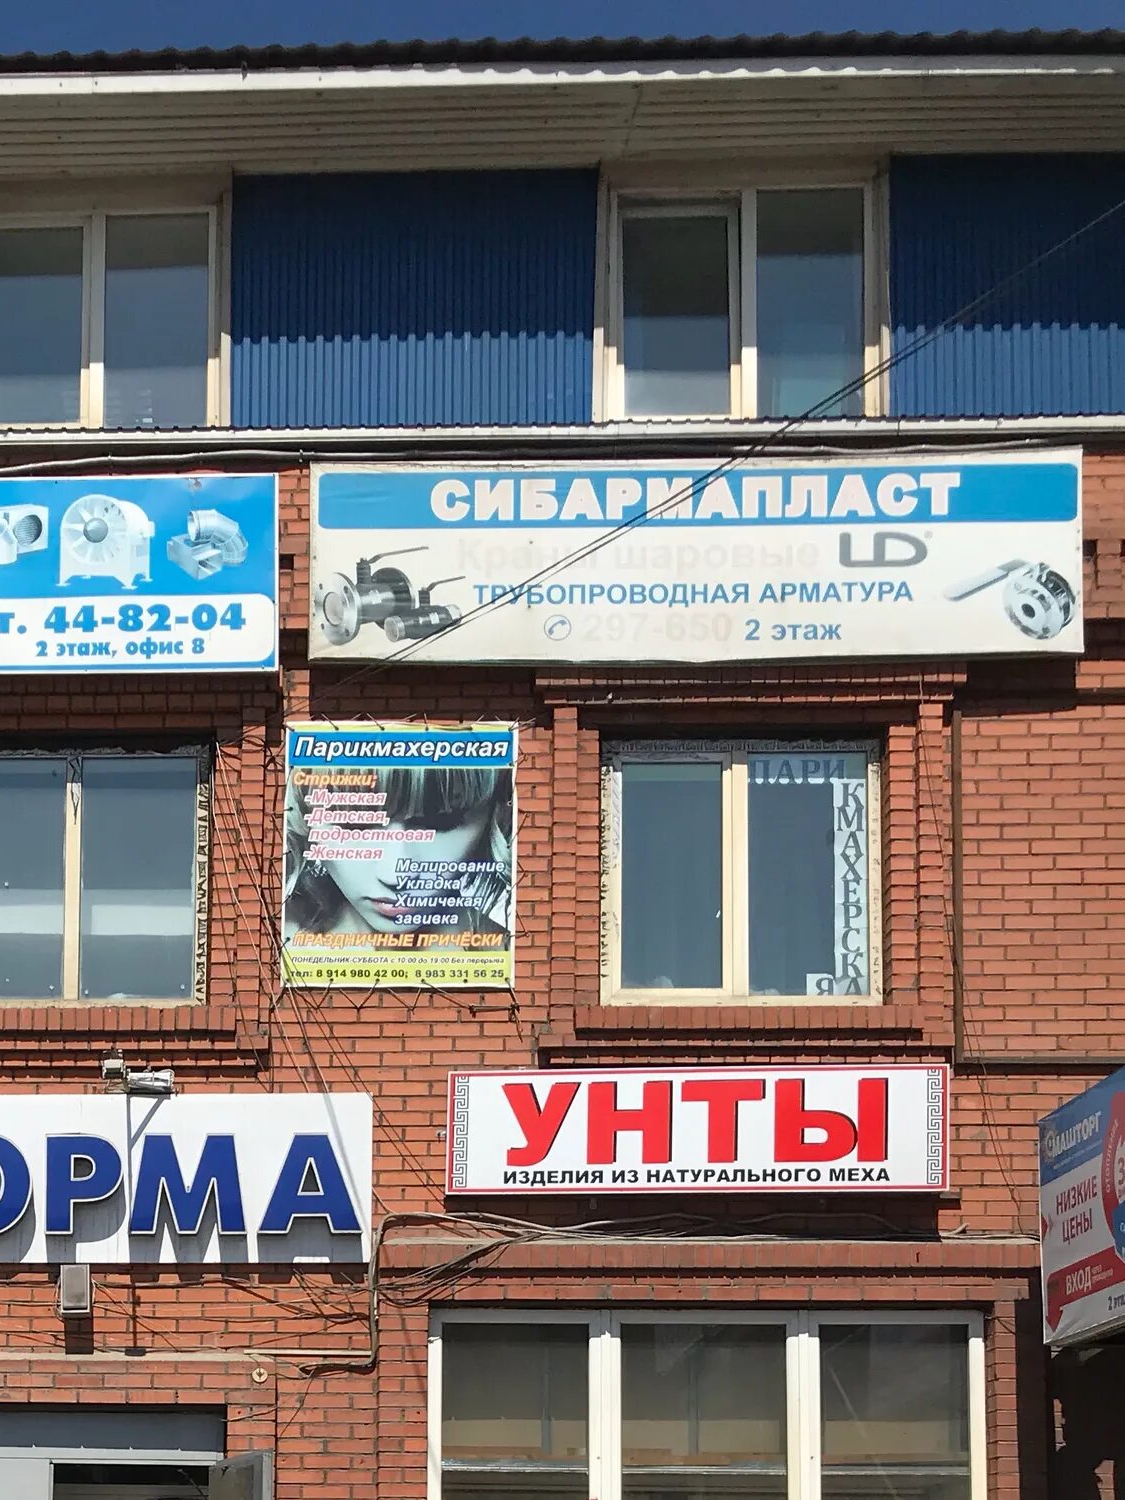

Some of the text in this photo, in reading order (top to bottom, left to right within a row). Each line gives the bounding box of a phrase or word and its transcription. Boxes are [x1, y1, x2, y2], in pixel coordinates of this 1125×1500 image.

[429, 471, 961, 522] СИБАРМАПЛАСТ
[473, 580, 913, 608] ТРУБОПРОВОДНАЯ АРМАТУРА
[44, 603, 246, 633] 44-82-04
[744, 620, 763, 641] 2
[771, 620, 842, 642] этаж
[35, 637, 205, 659] 2 этаж, офис 8
[294, 736, 508, 760] Парикмахерская
[305, 790, 386, 807] -Мужская
[308, 829, 435, 843] подростковая
[303, 846, 382, 860] -Женская
[395, 859, 505, 874] Мелирование
[395, 877, 461, 891] Укладка
[395, 912, 458, 926] завивка
[292, 933, 414, 949] ПРАЗДНИЧНЫЕ
[316, 969, 323, 978] 8
[325, 969, 346, 978] 914
[350, 969, 370, 978] 980
[374, 969, 388, 978] 42
[415, 969, 422, 978] 8
[425, 969, 446, 978] 983
[449, 969, 469, 978] 331
[473, 969, 488, 978] 56
[490, 969, 504, 978] 25
[501, 1077, 888, 1166] УНТЫ
[503, 1168, 890, 1186] ИЗДЕЛИЯ ИЗ НАТУРАЛЬНОГО МЕХА
[1056, 1175, 1097, 1215] НИЗКИЕ
[1062, 1208, 1093, 1246] ЦЕНЫ
[1066, 1266, 1092, 1296] ВХОД
